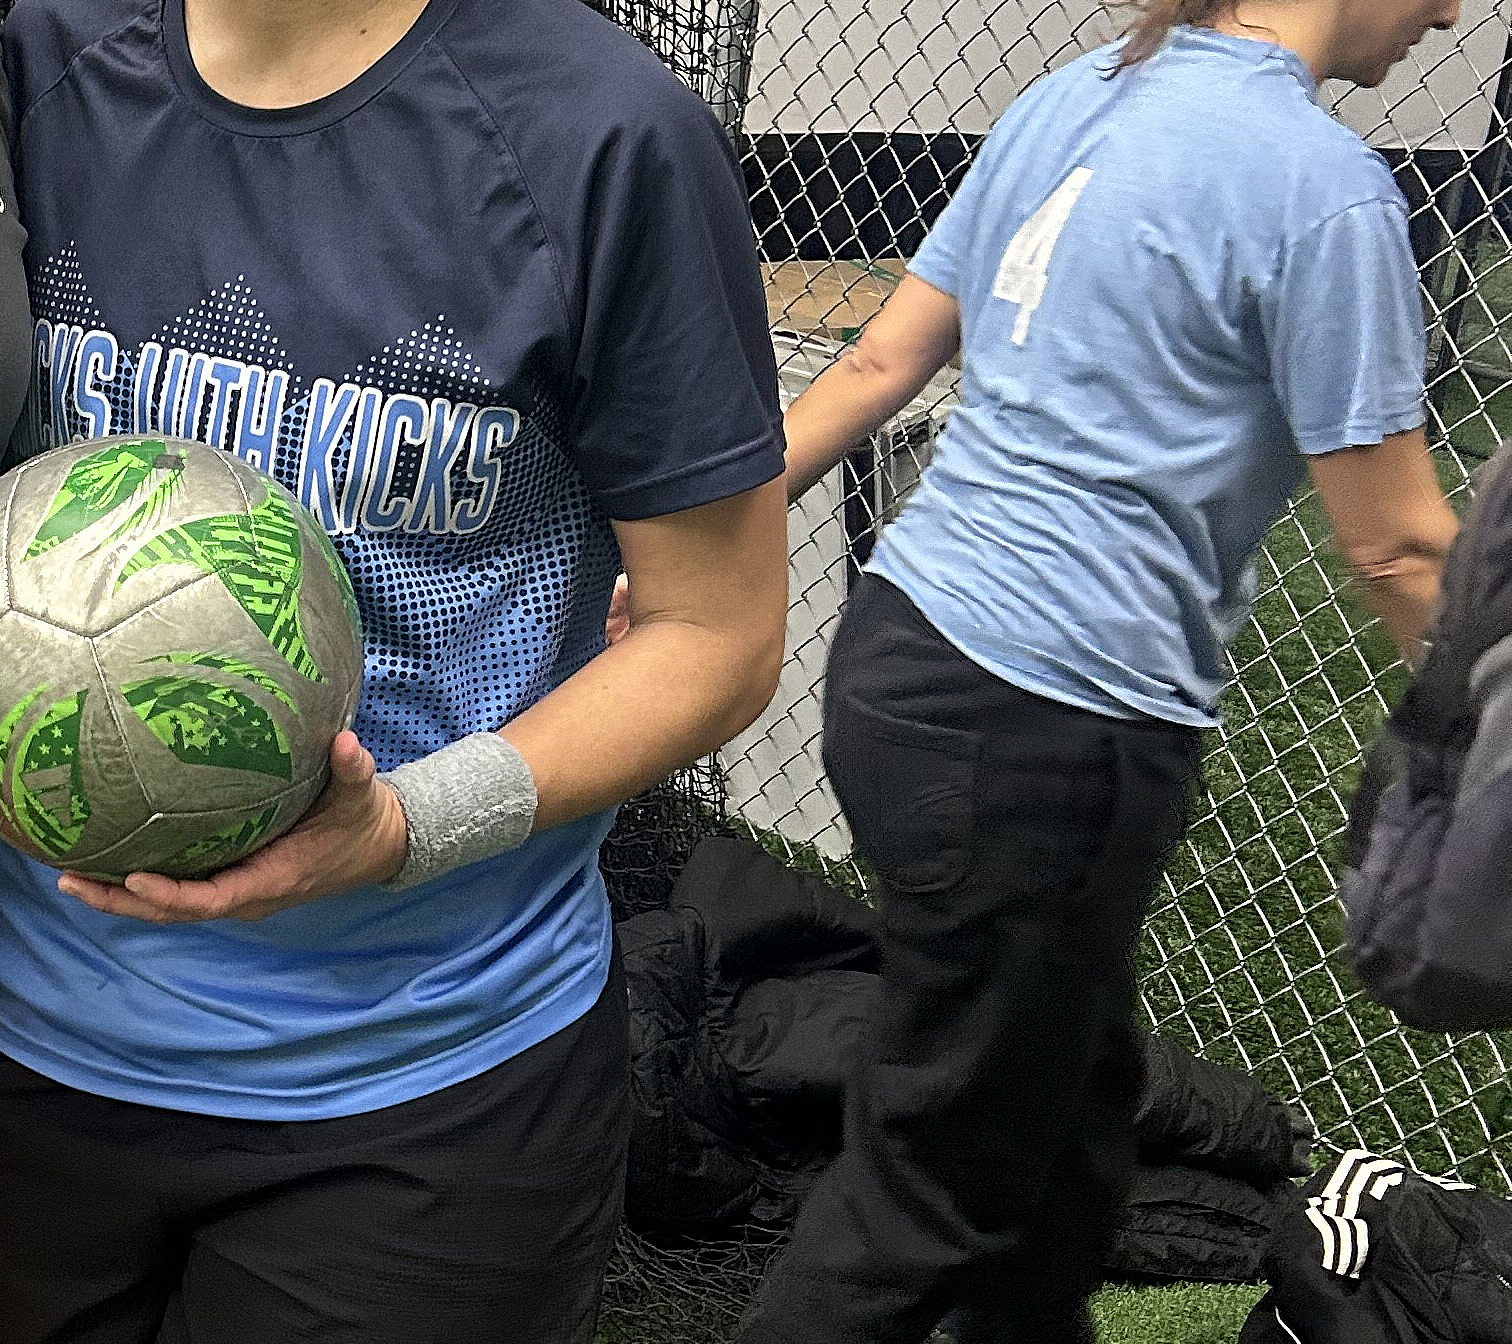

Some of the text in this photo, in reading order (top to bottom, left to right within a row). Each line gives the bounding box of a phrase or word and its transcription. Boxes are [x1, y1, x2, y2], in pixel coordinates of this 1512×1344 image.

[993, 167, 1095, 346] 4
[31, 317, 119, 450] CKS
[296, 378, 521, 535] KICKS
